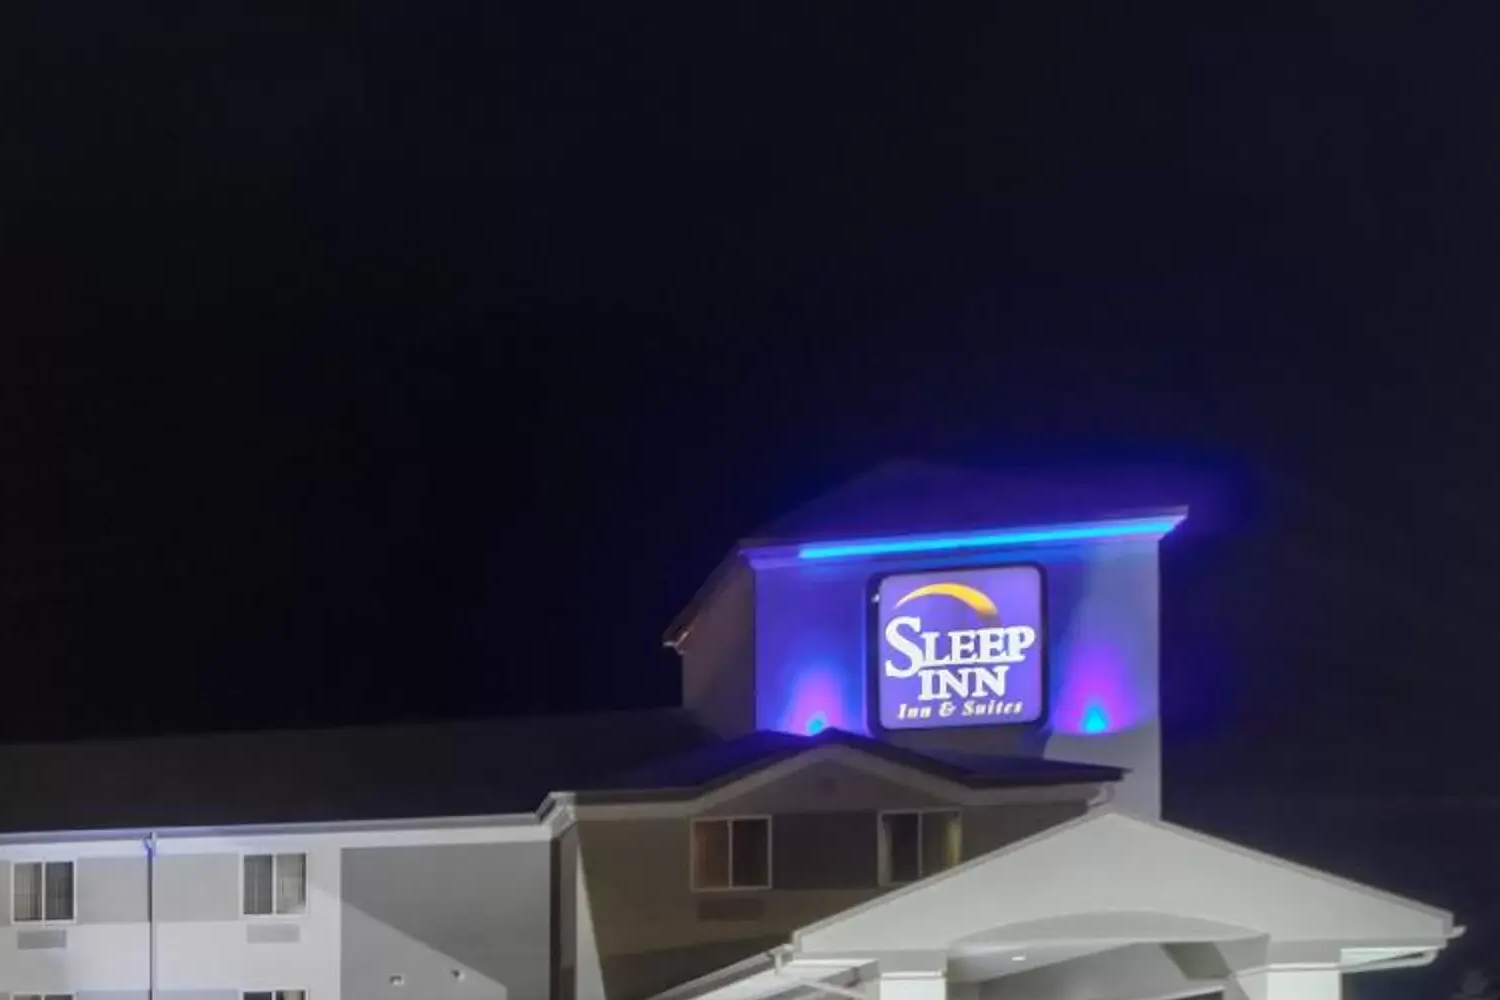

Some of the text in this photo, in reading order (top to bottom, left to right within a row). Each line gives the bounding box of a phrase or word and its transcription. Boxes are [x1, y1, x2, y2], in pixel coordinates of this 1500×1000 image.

[885, 616, 1036, 678] SLEEP
[918, 665, 1010, 700] INN
[898, 700, 1023, 719] Inn & Suites
